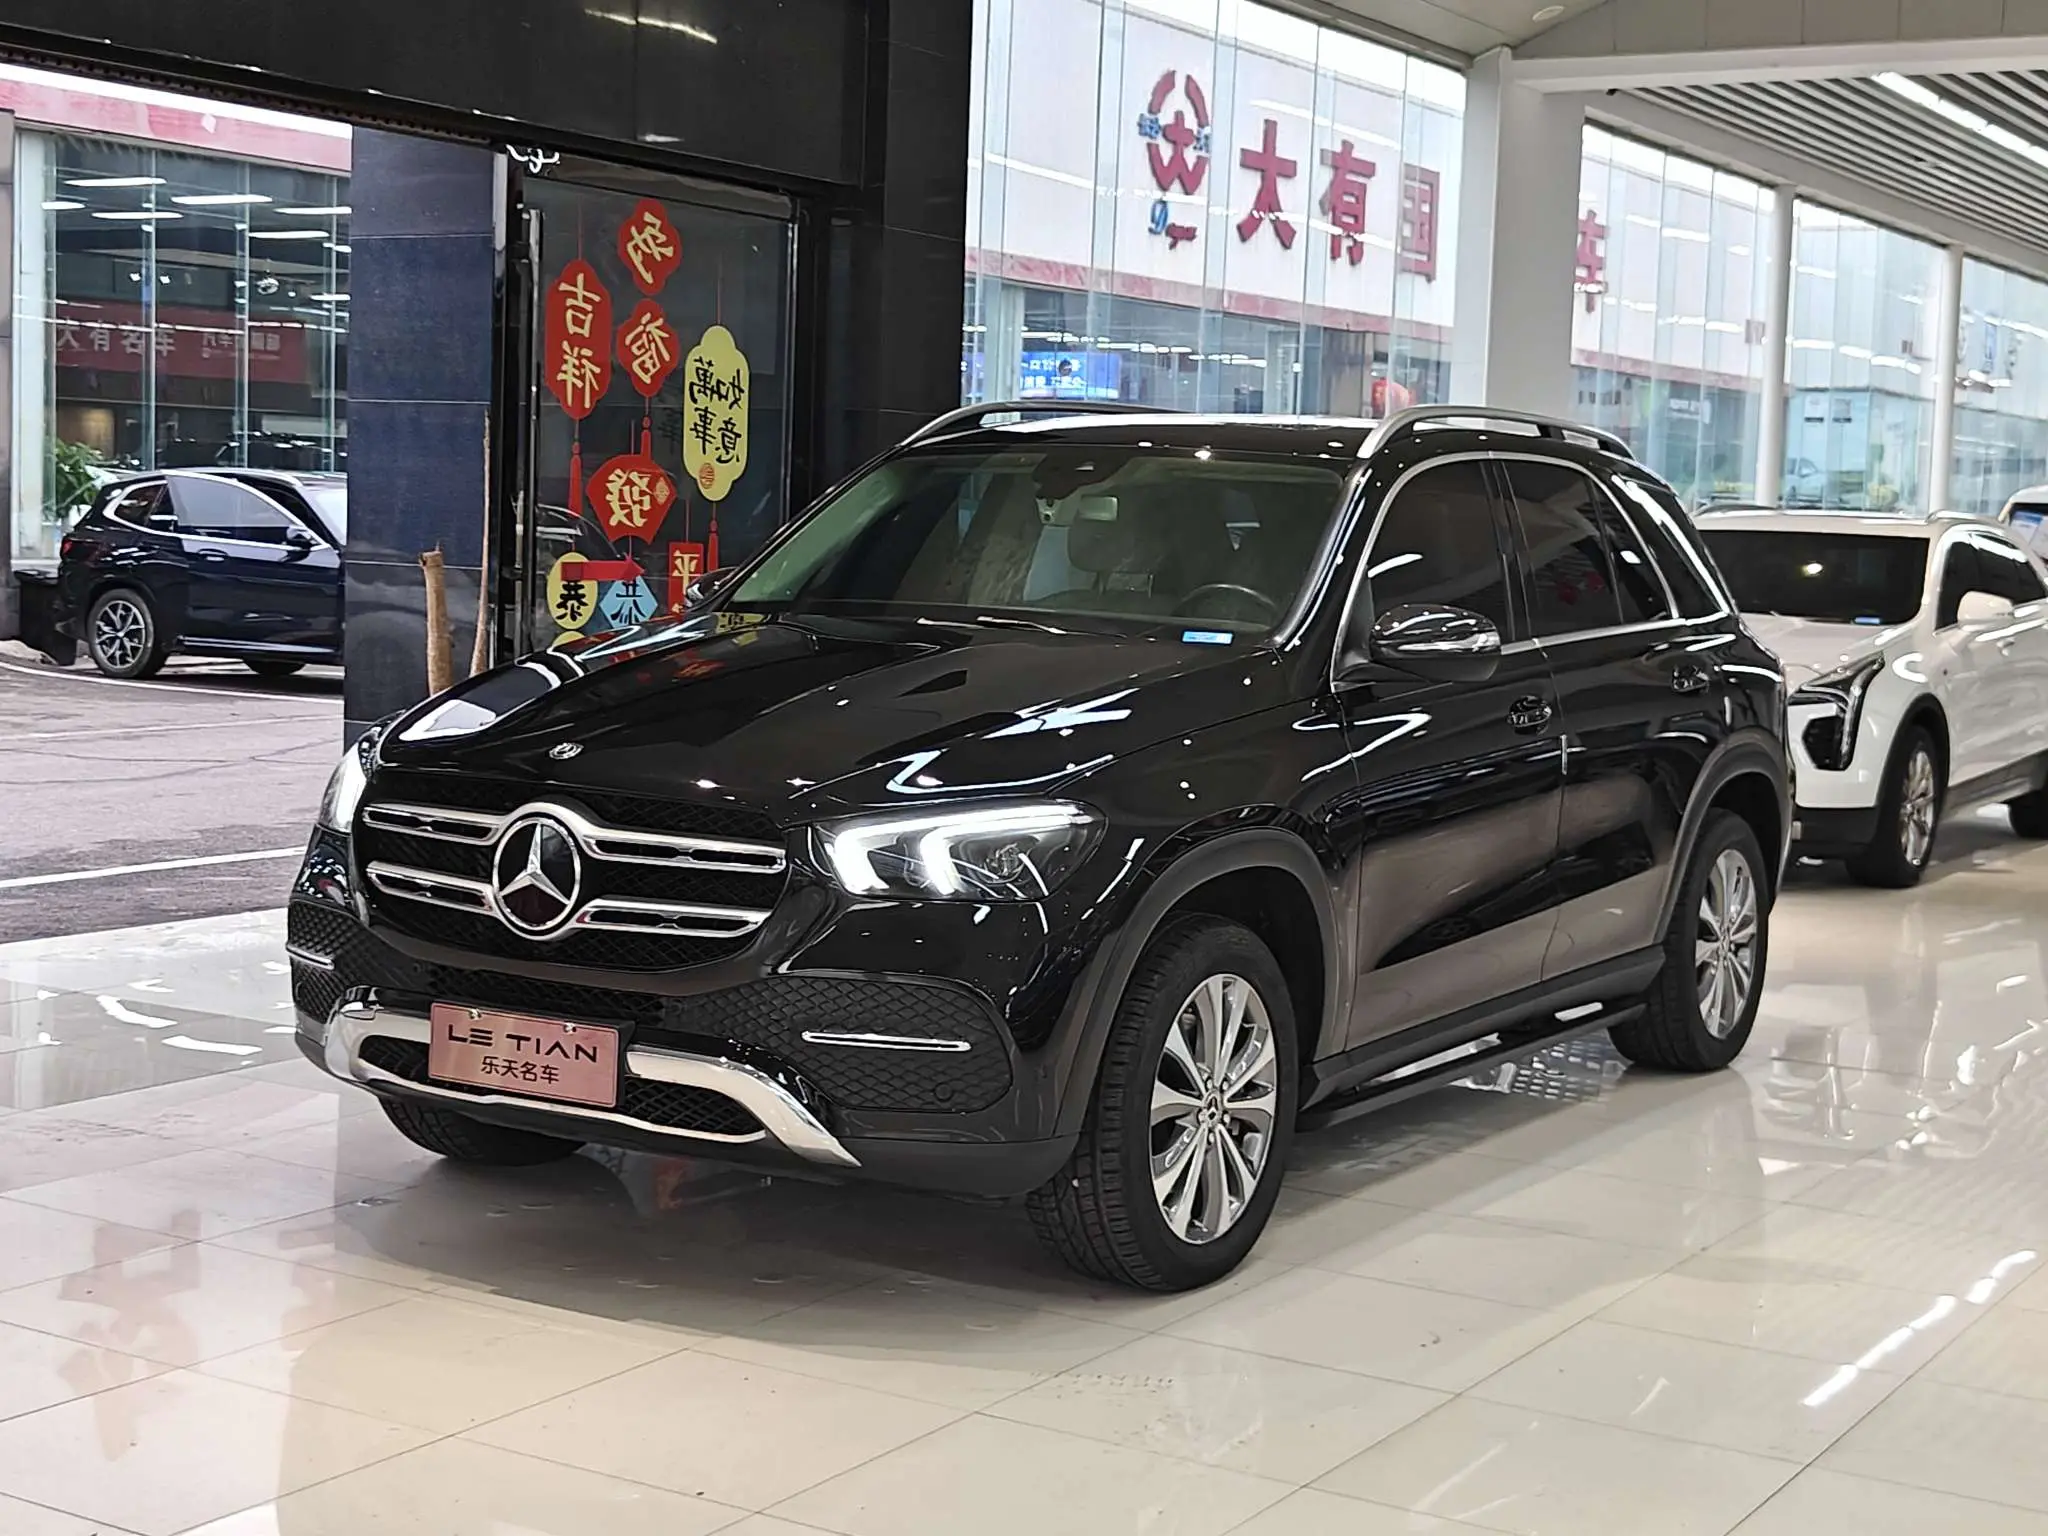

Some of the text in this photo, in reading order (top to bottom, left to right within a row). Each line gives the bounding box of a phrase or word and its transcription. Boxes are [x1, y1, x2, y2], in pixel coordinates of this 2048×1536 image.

[1236, 119, 1441, 284] 大有国
[448, 1024, 597, 1063] LE TIAN
[480, 1056, 560, 1085] 乐天名车
